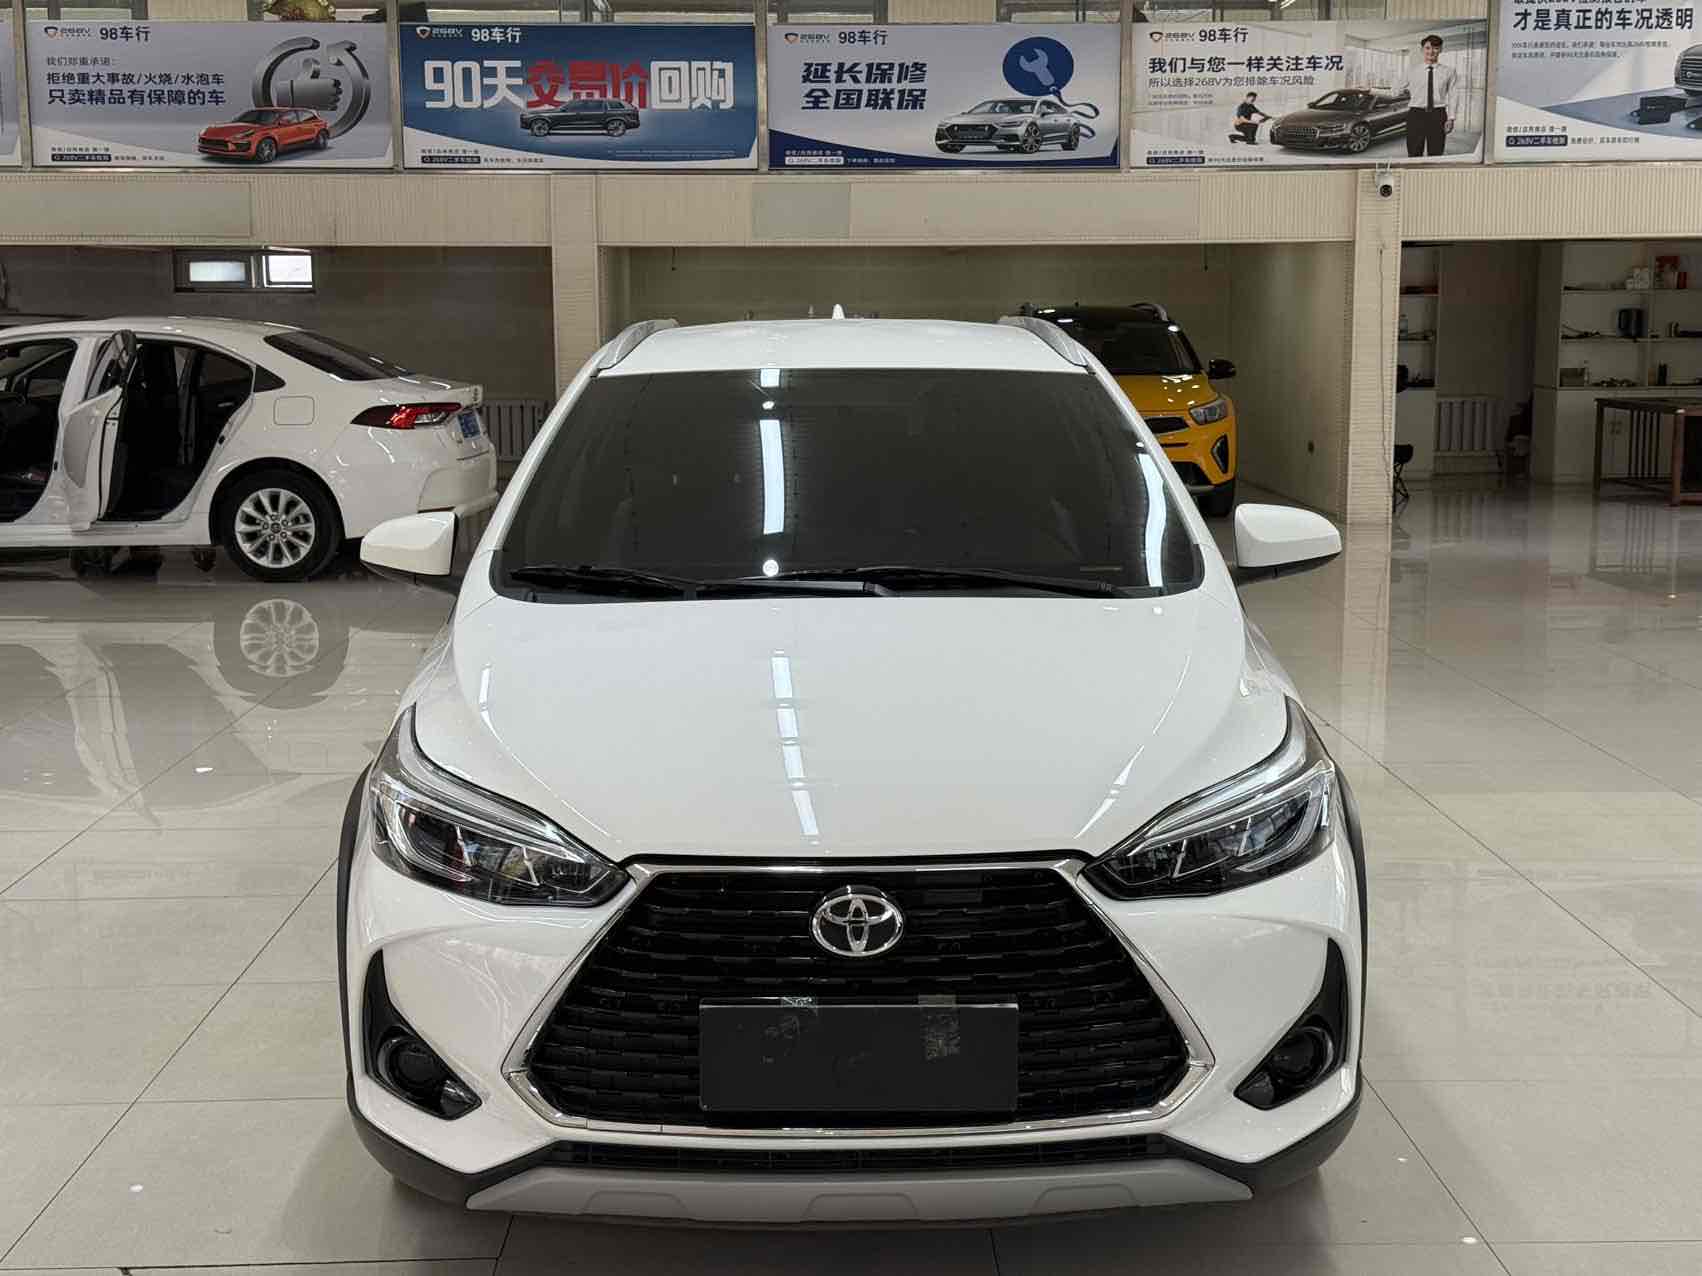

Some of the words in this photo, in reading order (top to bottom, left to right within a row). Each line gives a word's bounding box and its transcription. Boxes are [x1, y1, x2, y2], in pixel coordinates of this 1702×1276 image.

[1512, 8, 1694, 30] 才是真正的车况透明
[100, 25, 151, 42] 98车行
[471, 27, 522, 43] 98车行
[838, 30, 888, 46] 98车行
[1199, 27, 1249, 43] 98车行
[801, 62, 928, 84] 延长保修
[1148, 55, 1345, 74] 我们与您一样关注车况
[46, 72, 225, 86] 拒绝重大事故/火烧/水泡车
[424, 60, 735, 110] 90天交易价回购
[47, 89, 226, 106] 只卖精品有保障的车
[801, 88, 927, 111] 全国联保
